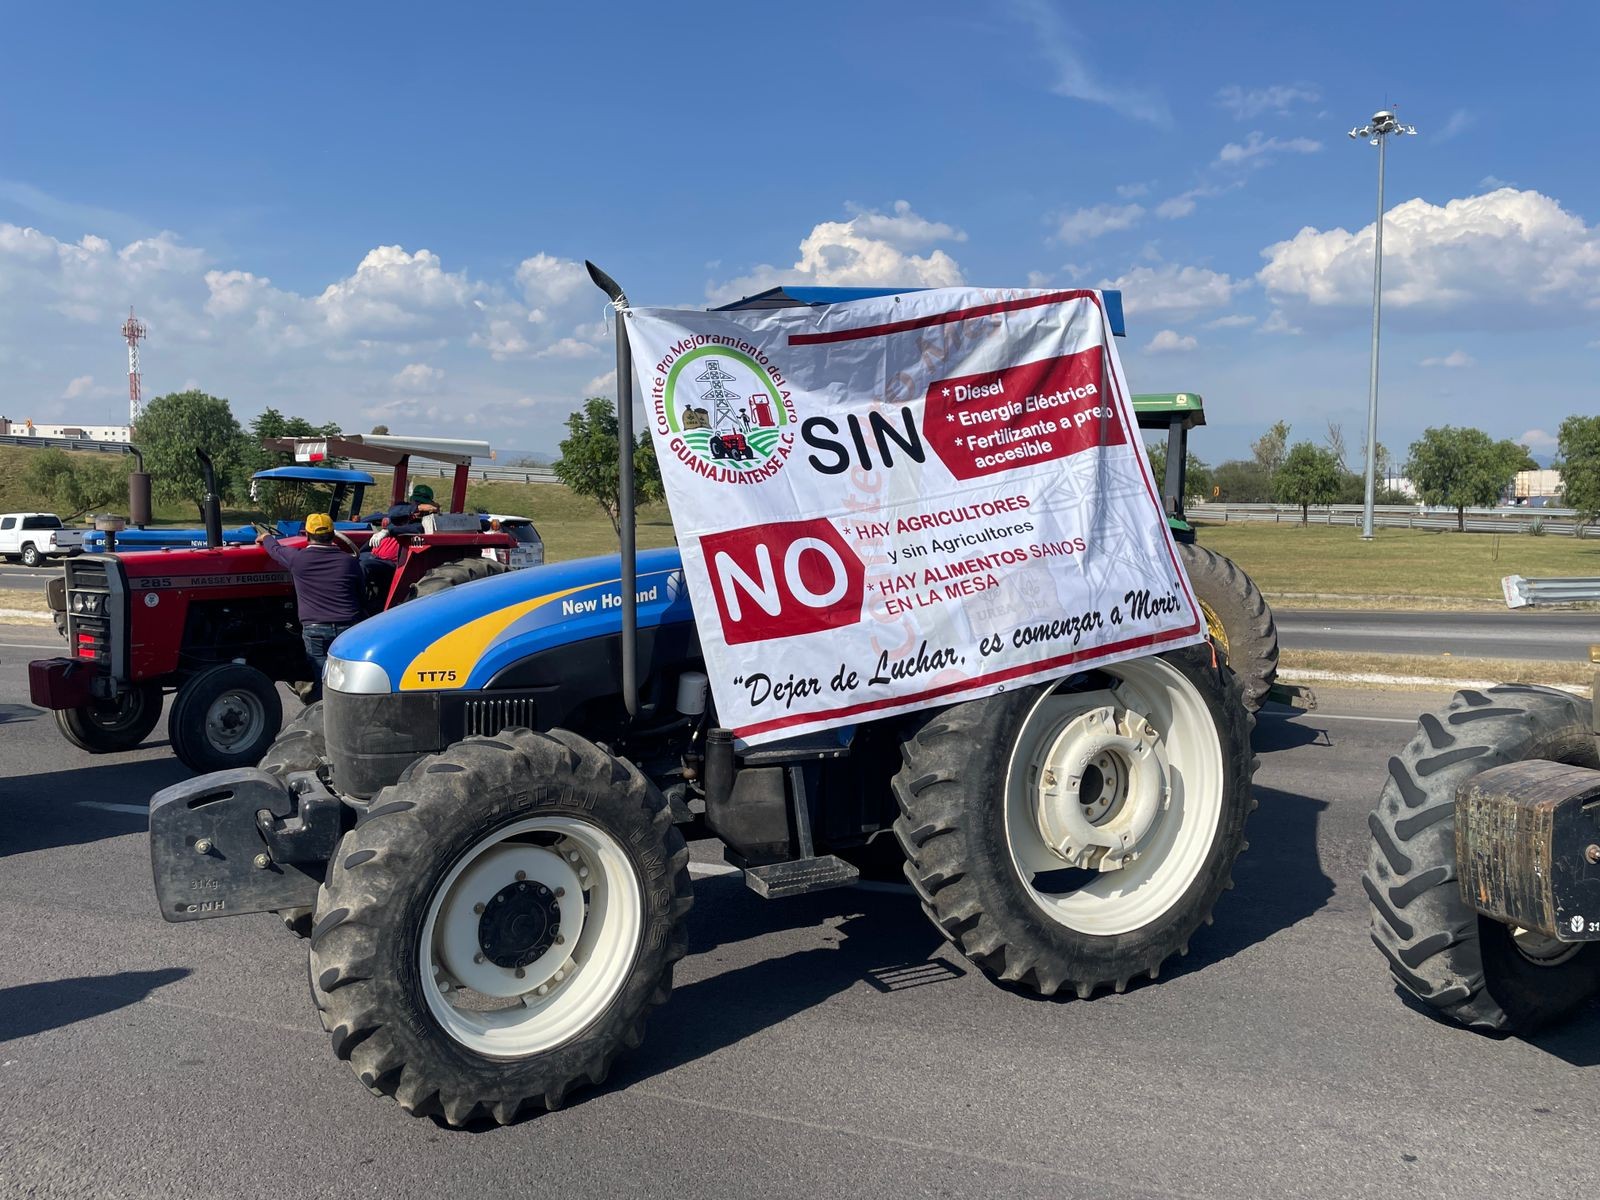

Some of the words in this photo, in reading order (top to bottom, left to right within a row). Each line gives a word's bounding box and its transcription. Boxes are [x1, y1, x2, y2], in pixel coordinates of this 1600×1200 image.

[656, 354, 674, 375] Pro
[670, 334, 769, 365] Mejoramiento
[767, 366, 786, 387] del
[955, 379, 1004, 402] Diesel
[652, 376, 670, 436] Comité
[780, 390, 798, 424] Agro
[958, 400, 1023, 426] Energía
[1025, 383, 1098, 412] Eléctrica
[801, 406, 926, 475] SIN
[967, 420, 1057, 451] Fertilizante
[1061, 417, 1072, 429] a
[669, 437, 784, 485] GUANAJUATENSE
[777, 432, 795, 460] A.C.
[975, 440, 1053, 468] accesible
[856, 521, 892, 540] HAY
[897, 495, 1031, 534] AGRICULTORES
[887, 550, 898, 565] y
[901, 543, 928, 560] sin
[931, 520, 1035, 555] Agricultores
[140, 578, 172, 588] 285
[191, 576, 232, 586] MASSEY
[236, 573, 284, 584] FERGUSON
[714, 537, 848, 622] NO
[879, 572, 917, 596] HAY
[923, 548, 1029, 585] ALIMENTOS
[1029, 537, 1087, 558] SANOS
[562, 598, 597, 616] New
[602, 586, 657, 609] Hond
[886, 598, 913, 615] EN
[916, 590, 943, 608] LA
[944, 574, 1000, 600] MESA
[830, 663, 859, 692] de
[868, 640, 966, 687] Luchar,
[979, 632, 1005, 657] es
[1012, 610, 1104, 646] comenzar
[1110, 605, 1123, 625] a
[417, 671, 457, 682] TT75
[187, 900, 225, 913] CNH
